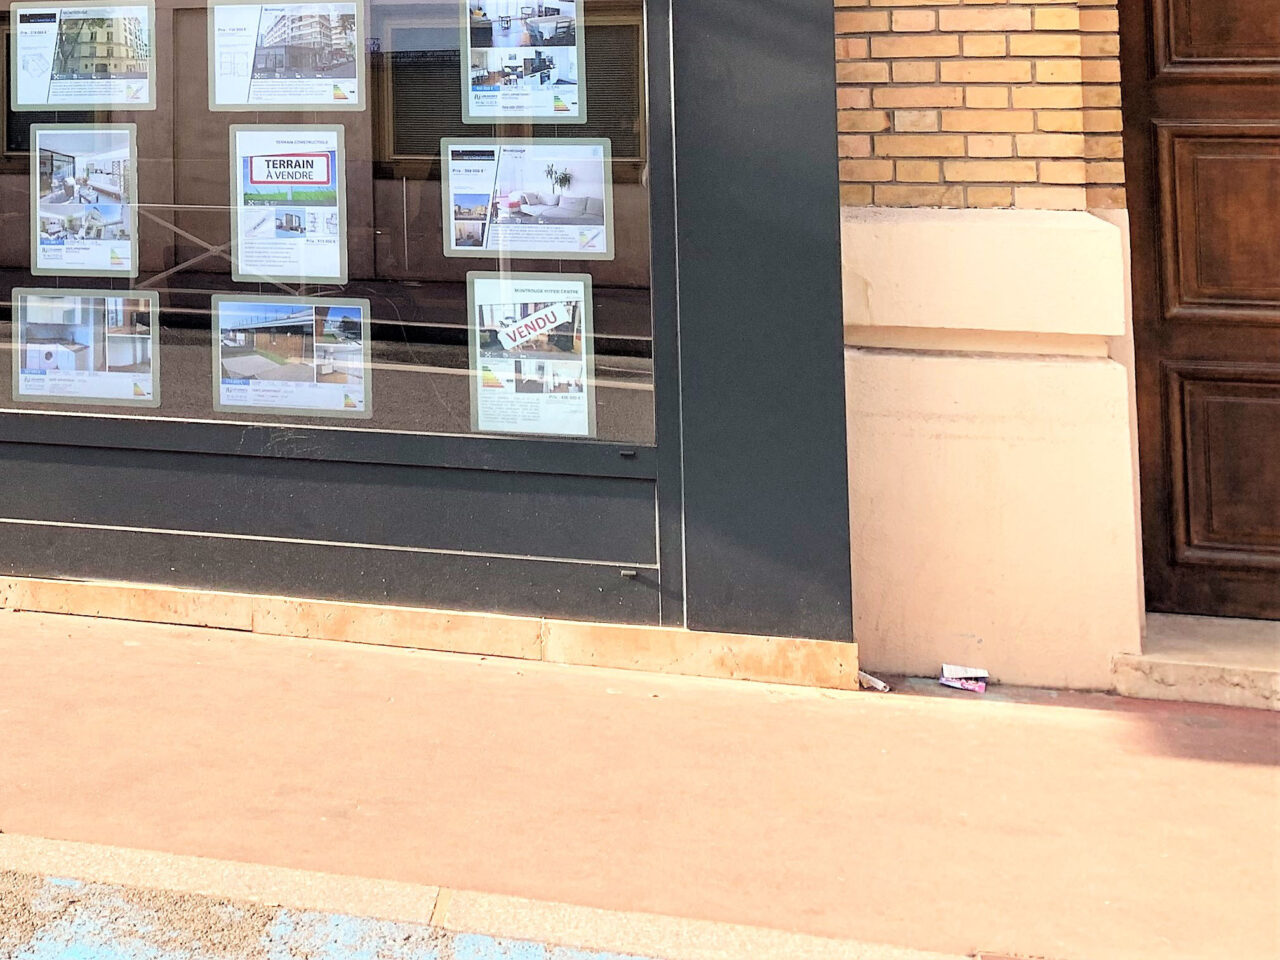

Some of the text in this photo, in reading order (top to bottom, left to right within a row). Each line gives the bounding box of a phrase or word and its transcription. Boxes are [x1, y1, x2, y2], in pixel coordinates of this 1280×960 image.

[264, 159, 314, 169] TERRAIN
[265, 169, 314, 180] À VENDRE
[505, 310, 558, 344] VENDU
